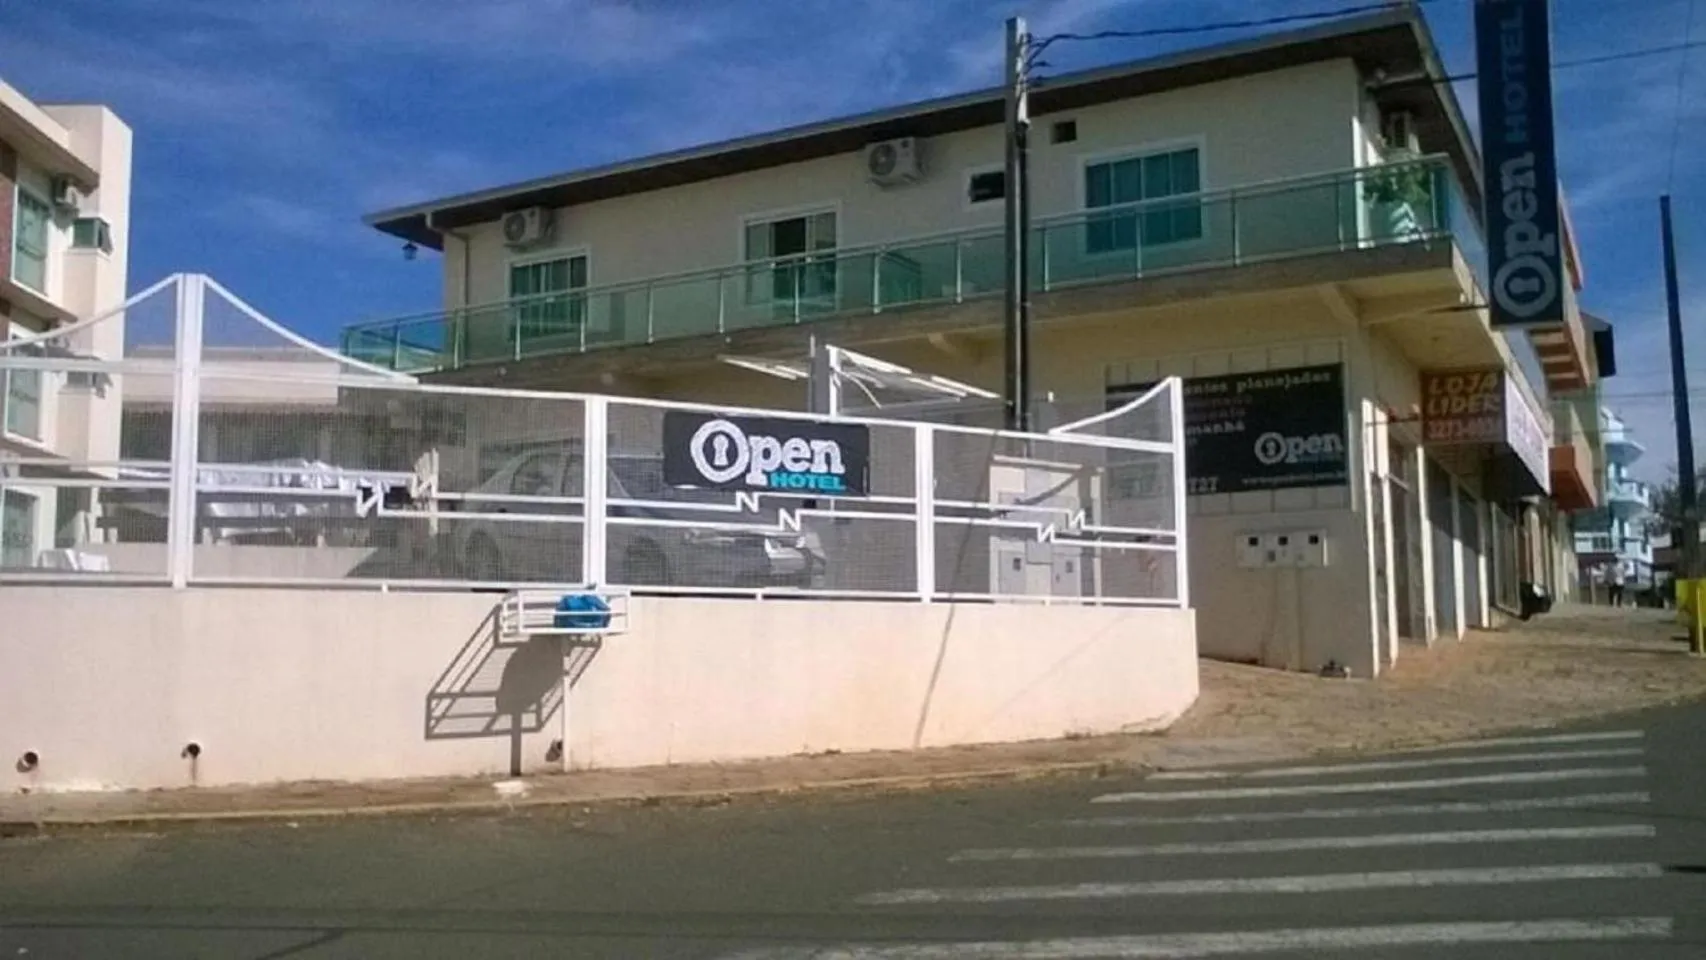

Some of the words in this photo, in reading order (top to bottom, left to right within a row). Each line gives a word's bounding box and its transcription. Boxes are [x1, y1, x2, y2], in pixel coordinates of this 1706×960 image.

[1501, 5, 1528, 143] HOTEL
[1493, 151, 1557, 318] Open
[1428, 373, 1498, 395] LOJA
[690, 419, 846, 486] Open
[1254, 431, 1345, 465] Open
[769, 472, 847, 491] HOTEL
